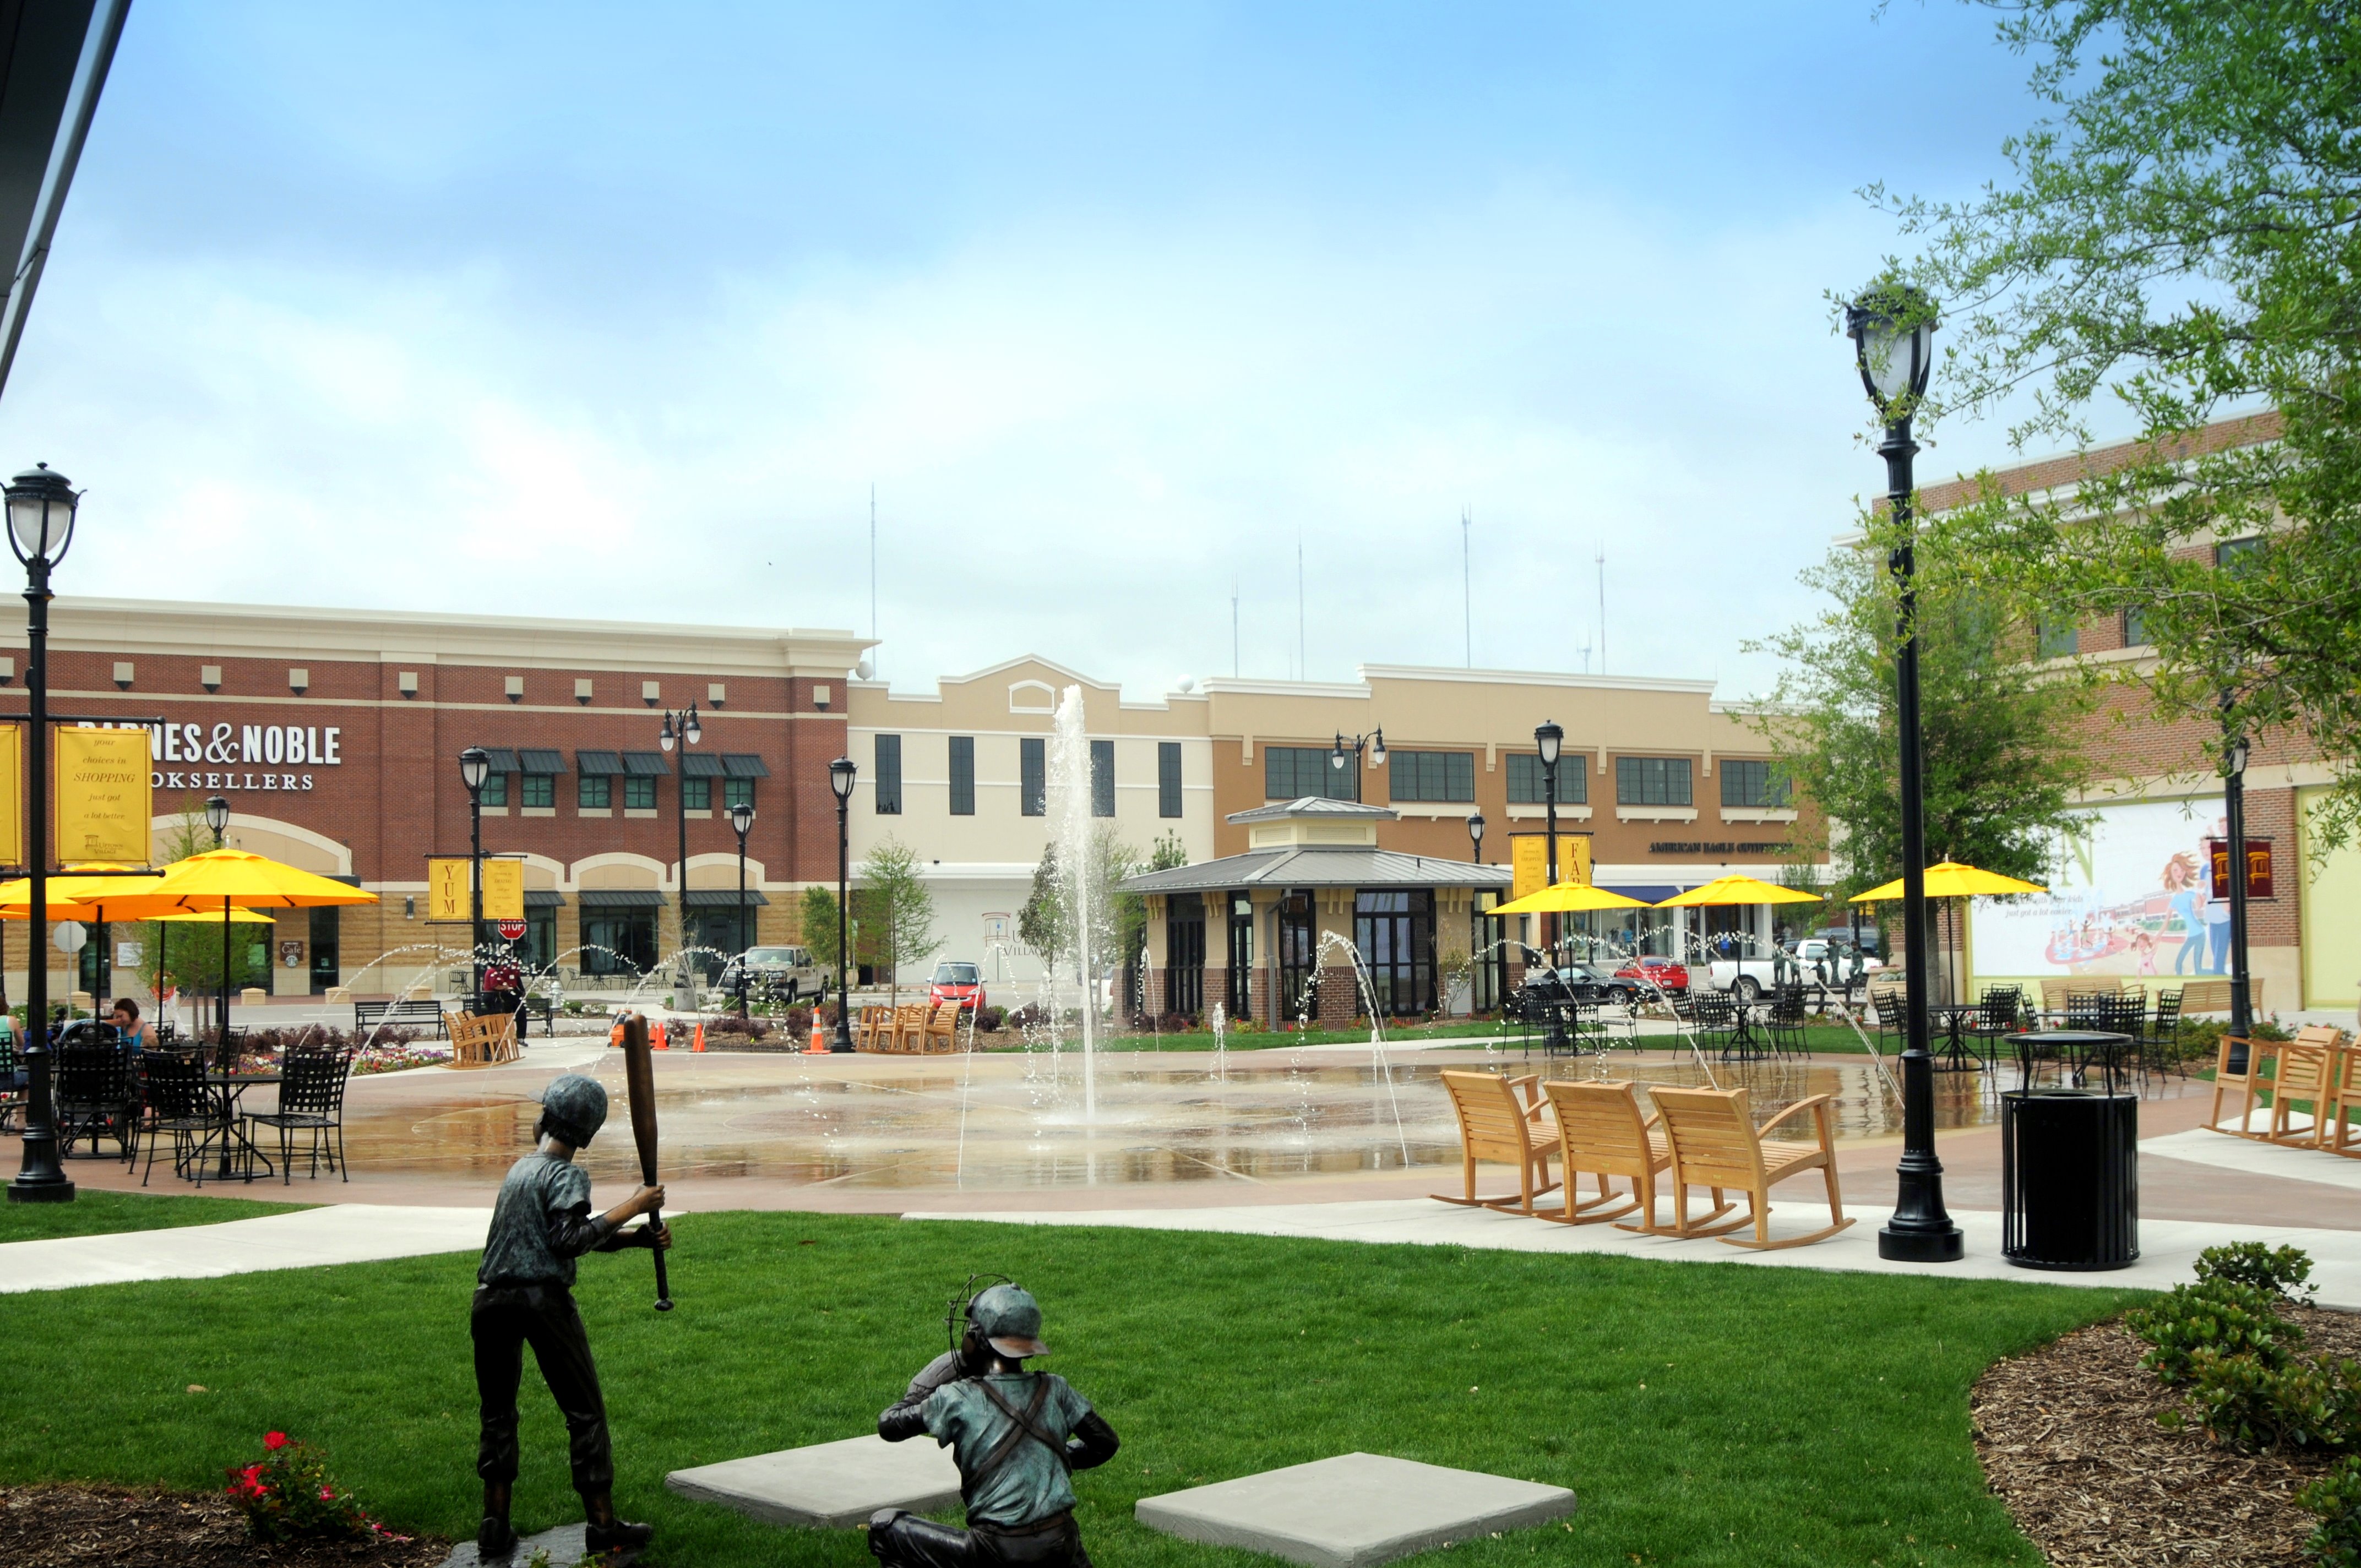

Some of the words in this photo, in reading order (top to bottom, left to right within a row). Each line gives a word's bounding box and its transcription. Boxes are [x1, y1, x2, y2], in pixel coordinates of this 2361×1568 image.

[205, 722, 240, 764] &
[243, 725, 341, 764] NOBLE
[82, 756, 115, 764] choices
[73, 772, 135, 783] SHOPPING
[151, 771, 313, 790] OKSELLERS
[88, 793, 105, 802] just
[107, 794, 121, 802] got
[443, 865, 455, 914] YUM
[501, 920, 524, 931] STOP
[282, 945, 302, 954] Café
[1003, 945, 1042, 956] VILLAG
